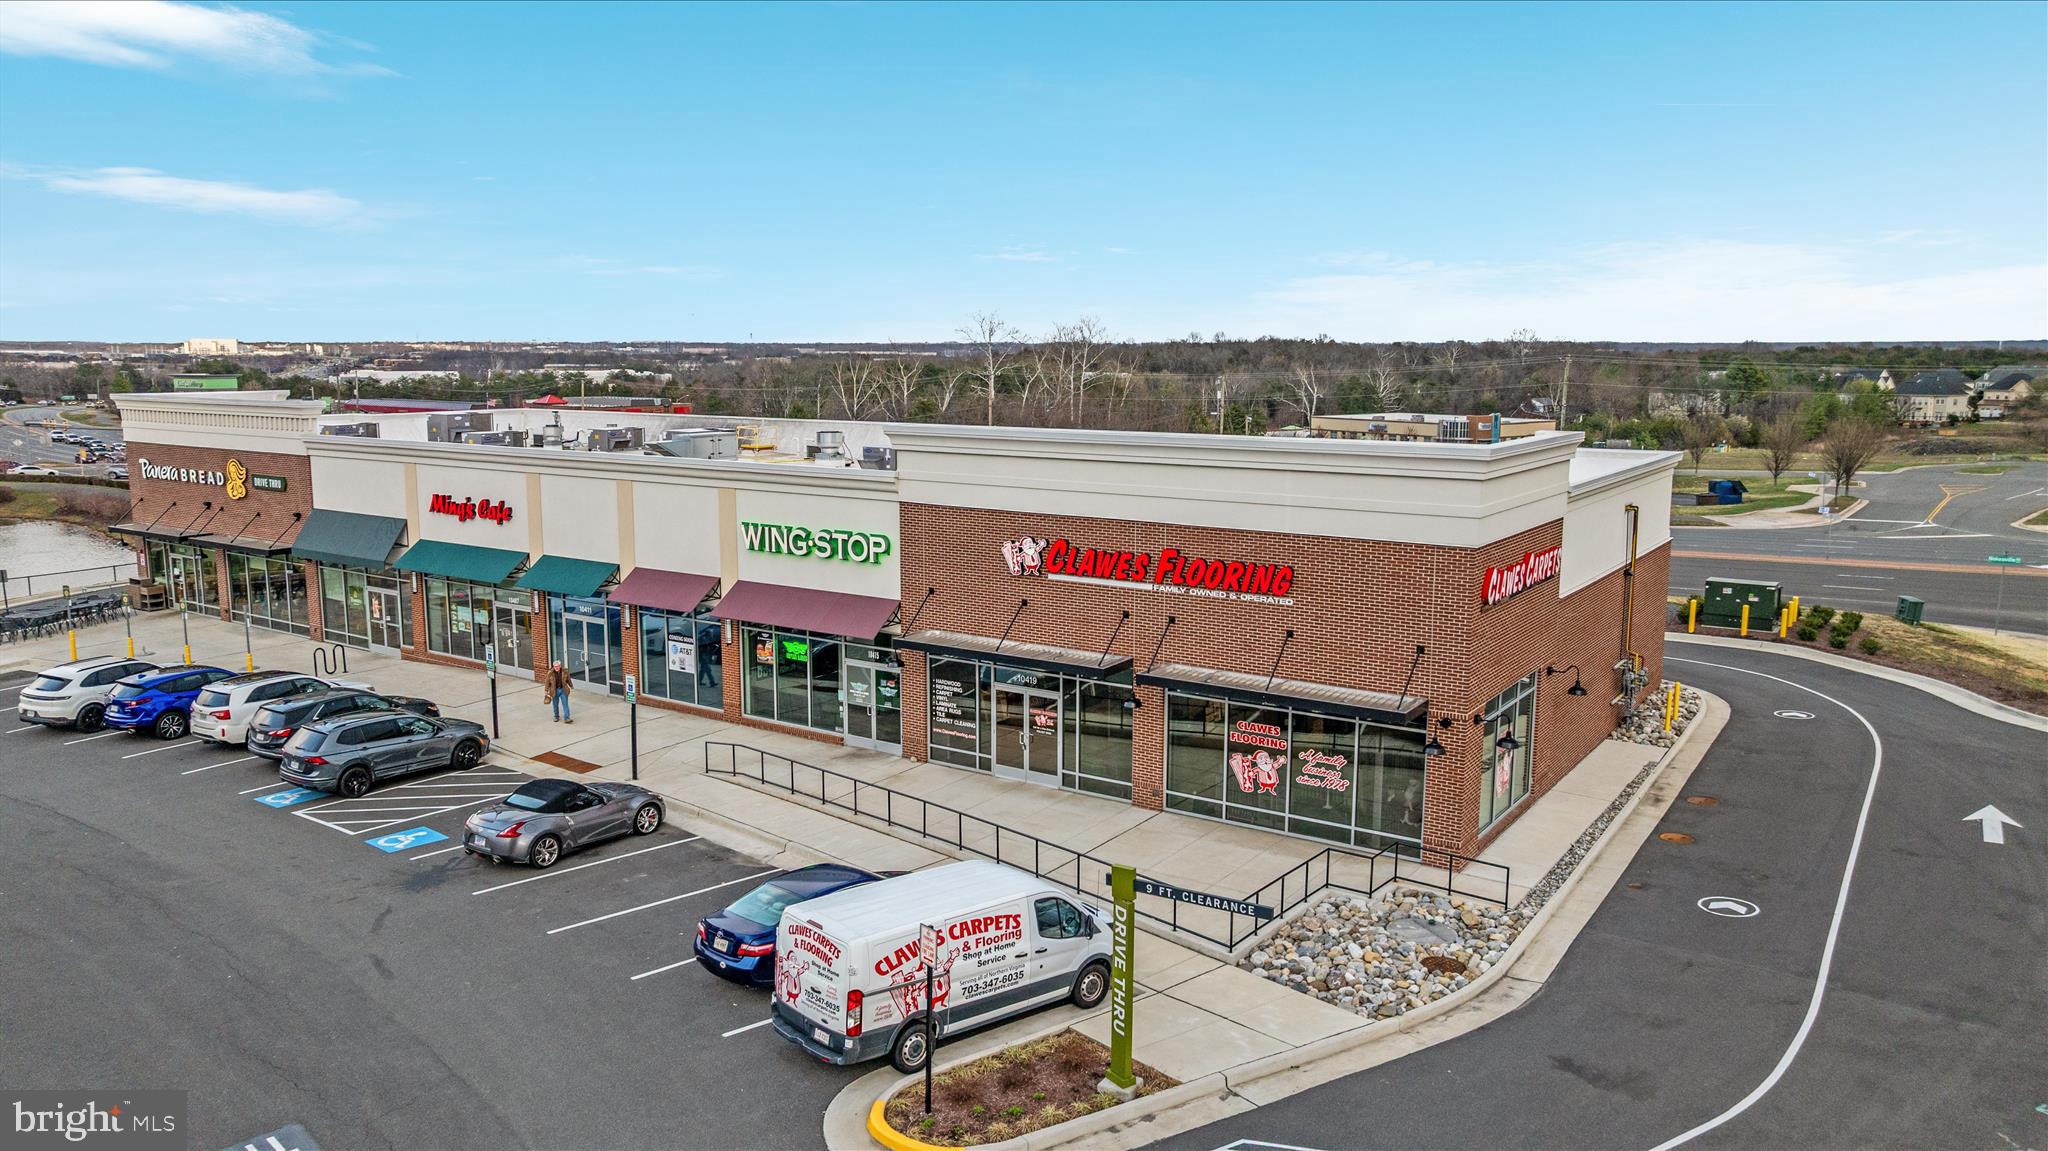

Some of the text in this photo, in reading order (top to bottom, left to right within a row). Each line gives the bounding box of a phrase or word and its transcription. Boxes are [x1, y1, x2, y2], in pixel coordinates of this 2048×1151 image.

[139, 459, 224, 486] Panera BREAD
[254, 477, 281, 489] DRIVE THRU
[429, 494, 513, 525] Ming's Cafe
[1046, 538, 1294, 596] CLAWES FLOORING
[1484, 547, 1561, 606] CLAWES CARPETS
[1153, 585, 1186, 594] FAMILY
[1190, 589, 1226, 598] OWNED
[1241, 595, 1294, 606] OPERATED
[679, 647, 692, 655] AT&T
[936, 679, 961, 687] HARDWOOD
[1018, 675, 1037, 685] 10419
[954, 720, 976, 728] CLEANING
[1237, 720, 1281, 736] CLAWES
[1230, 731, 1288, 750] FLOORING
[1302, 764, 1342, 779] business
[1312, 752, 1347, 770] family
[1296, 775, 1350, 792] since 1978
[1146, 884, 1255, 916] 9 FT. CLEARANCE
[788, 924, 842, 960] CLAWES CARPETS
[875, 929, 945, 976] CLAWS
[949, 914, 1021, 941] CARPETS
[962, 928, 1022, 952] & Flooring
[794, 938, 833, 968] & FLOORING
[963, 950, 982, 962] Shop
[994, 942, 1016, 952] Home
[977, 954, 1007, 967] Service
[960, 977, 977, 986] Serving
[989, 967, 1009, 978] Northern
[1009, 963, 1025, 972] Virginia
[1113, 905, 1127, 1036] DRIVE THRU
[961, 970, 1024, 996] 703-347-6035
[965, 981, 1019, 1000] clawescarpets.com
[804, 989, 840, 1012] 703-347-6035
